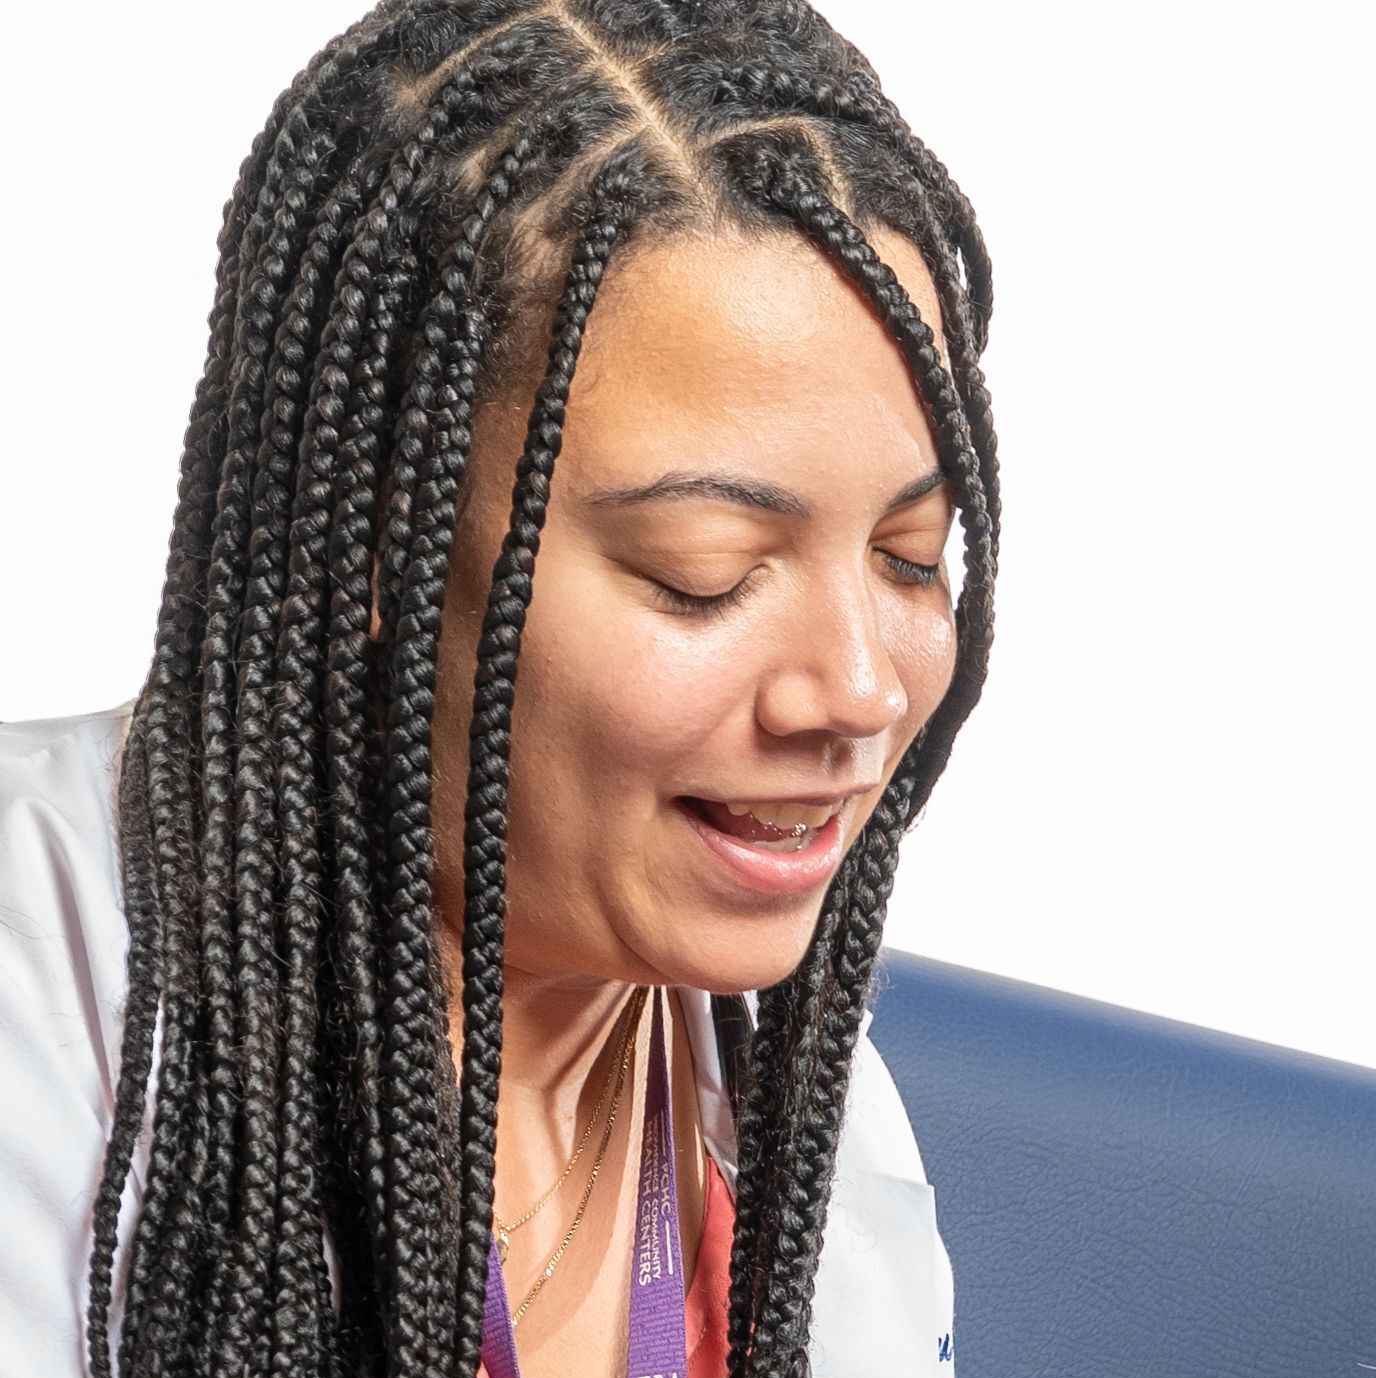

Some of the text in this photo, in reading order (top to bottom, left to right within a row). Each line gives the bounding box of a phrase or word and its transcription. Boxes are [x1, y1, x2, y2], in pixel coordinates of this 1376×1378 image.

[659, 1162, 672, 1214] PCHC
[638, 1200, 651, 1287] CENTERS
[651, 1198, 661, 1280] COMMUNITY
